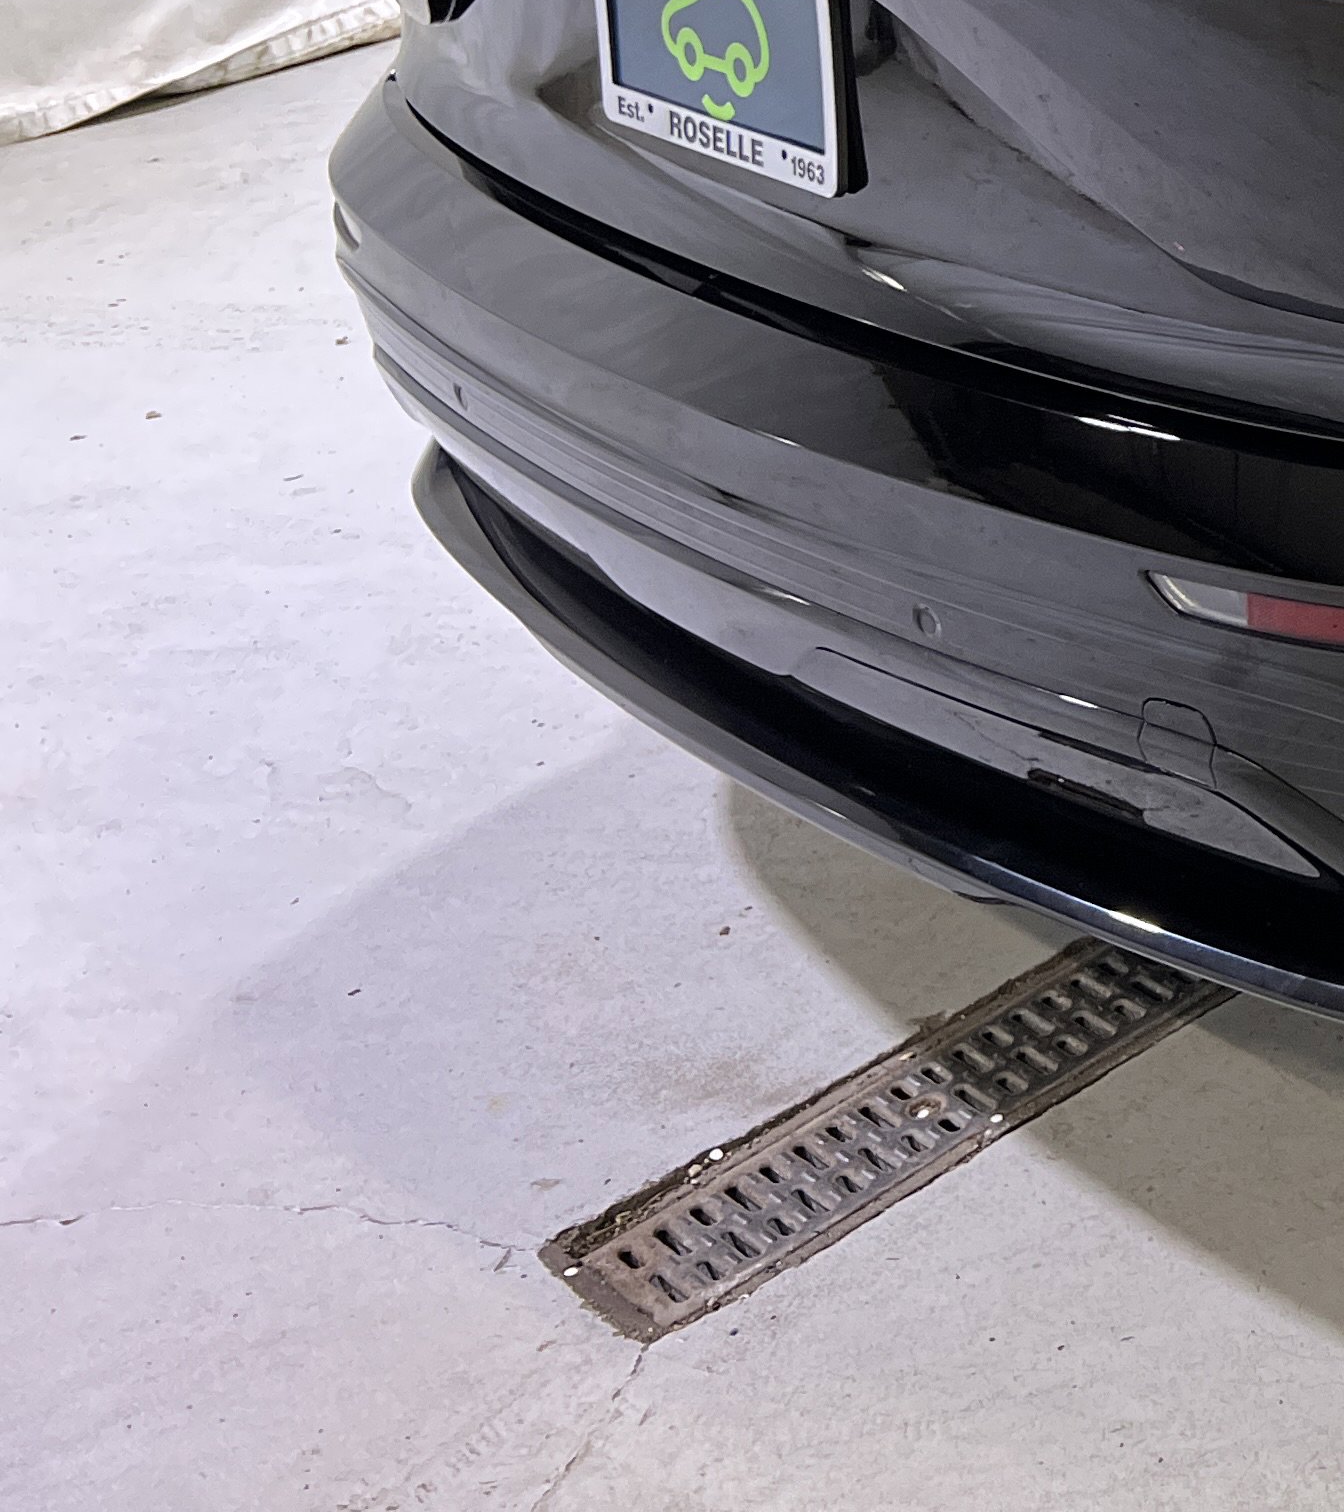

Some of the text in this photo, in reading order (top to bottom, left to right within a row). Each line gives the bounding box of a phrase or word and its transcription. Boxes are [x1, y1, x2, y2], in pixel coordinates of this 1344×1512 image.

[617, 95, 825, 185] Est. ROSELLE 1963
